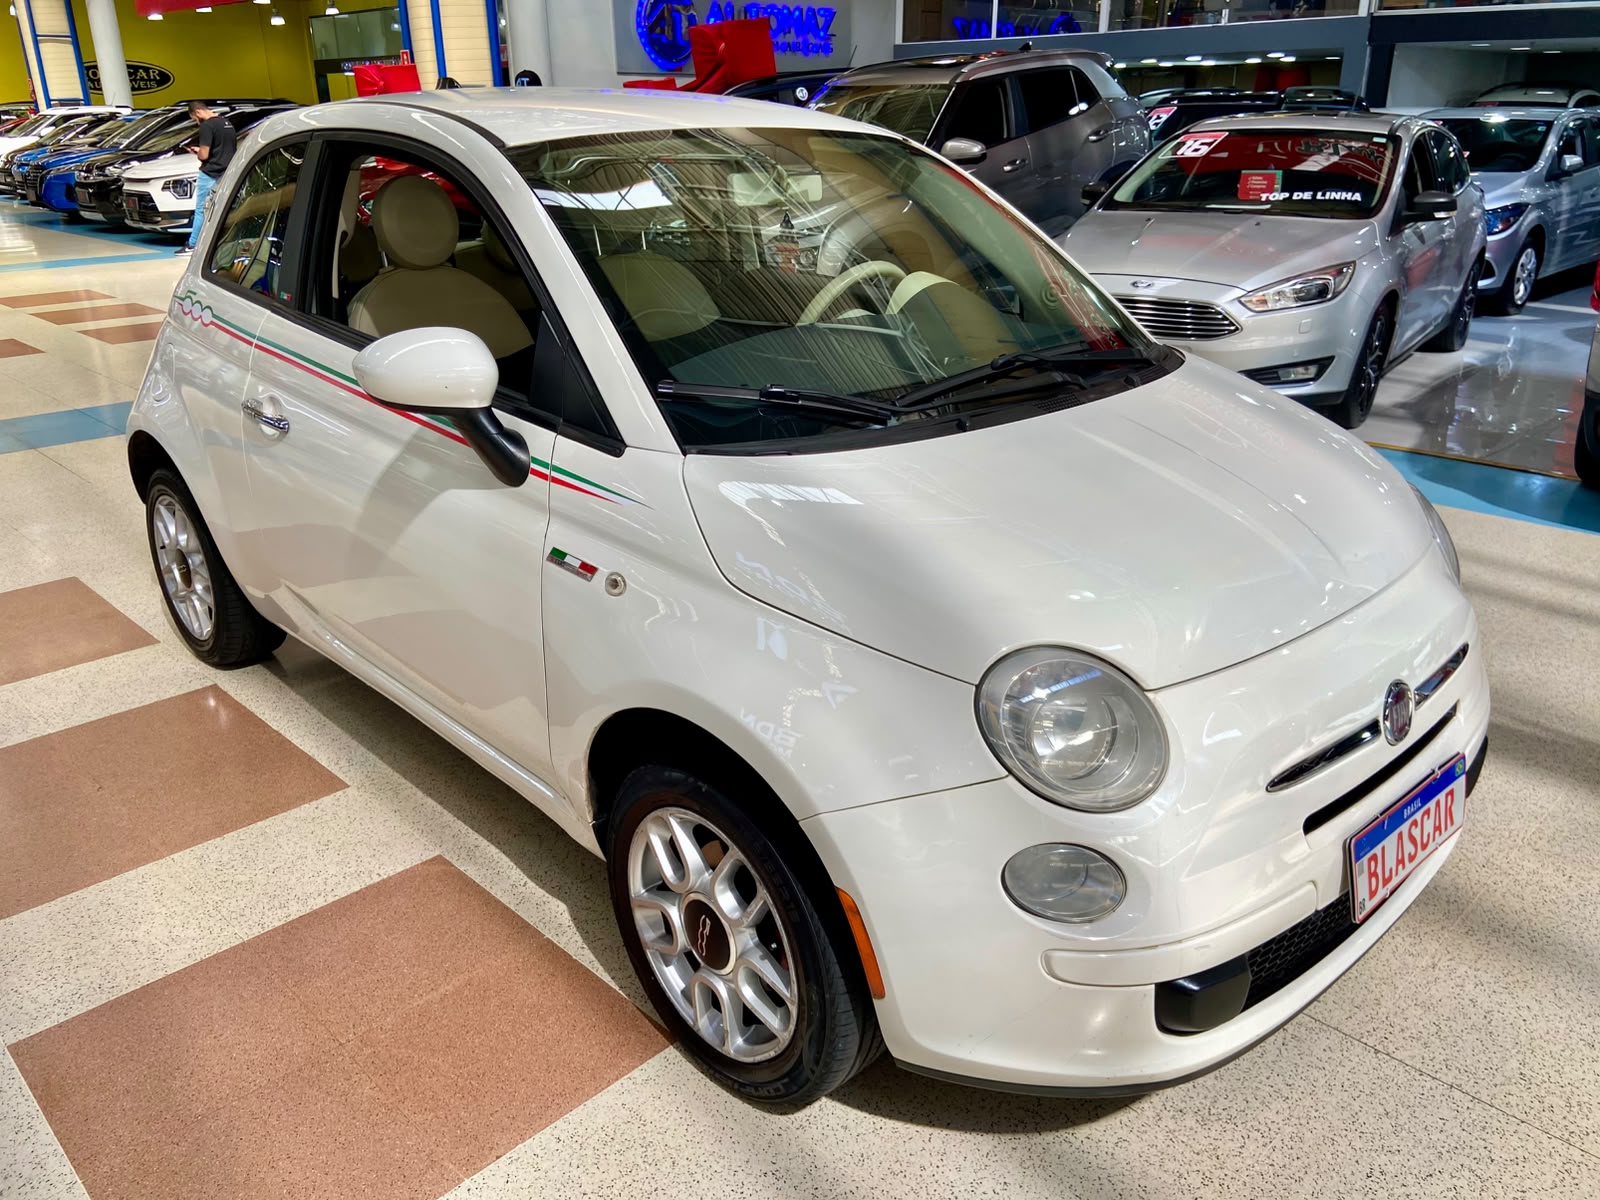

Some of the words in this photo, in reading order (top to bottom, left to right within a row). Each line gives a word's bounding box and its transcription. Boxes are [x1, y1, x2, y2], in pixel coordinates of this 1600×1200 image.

[1177, 139, 1216, 155] 16
[1260, 192, 1290, 201] TOP
[1292, 191, 1313, 200] DE
[1316, 191, 1361, 201] LINHA
[1403, 797, 1422, 819] BRASIL
[1367, 787, 1455, 902] BLASCAR
[1359, 897, 1366, 915] BR
